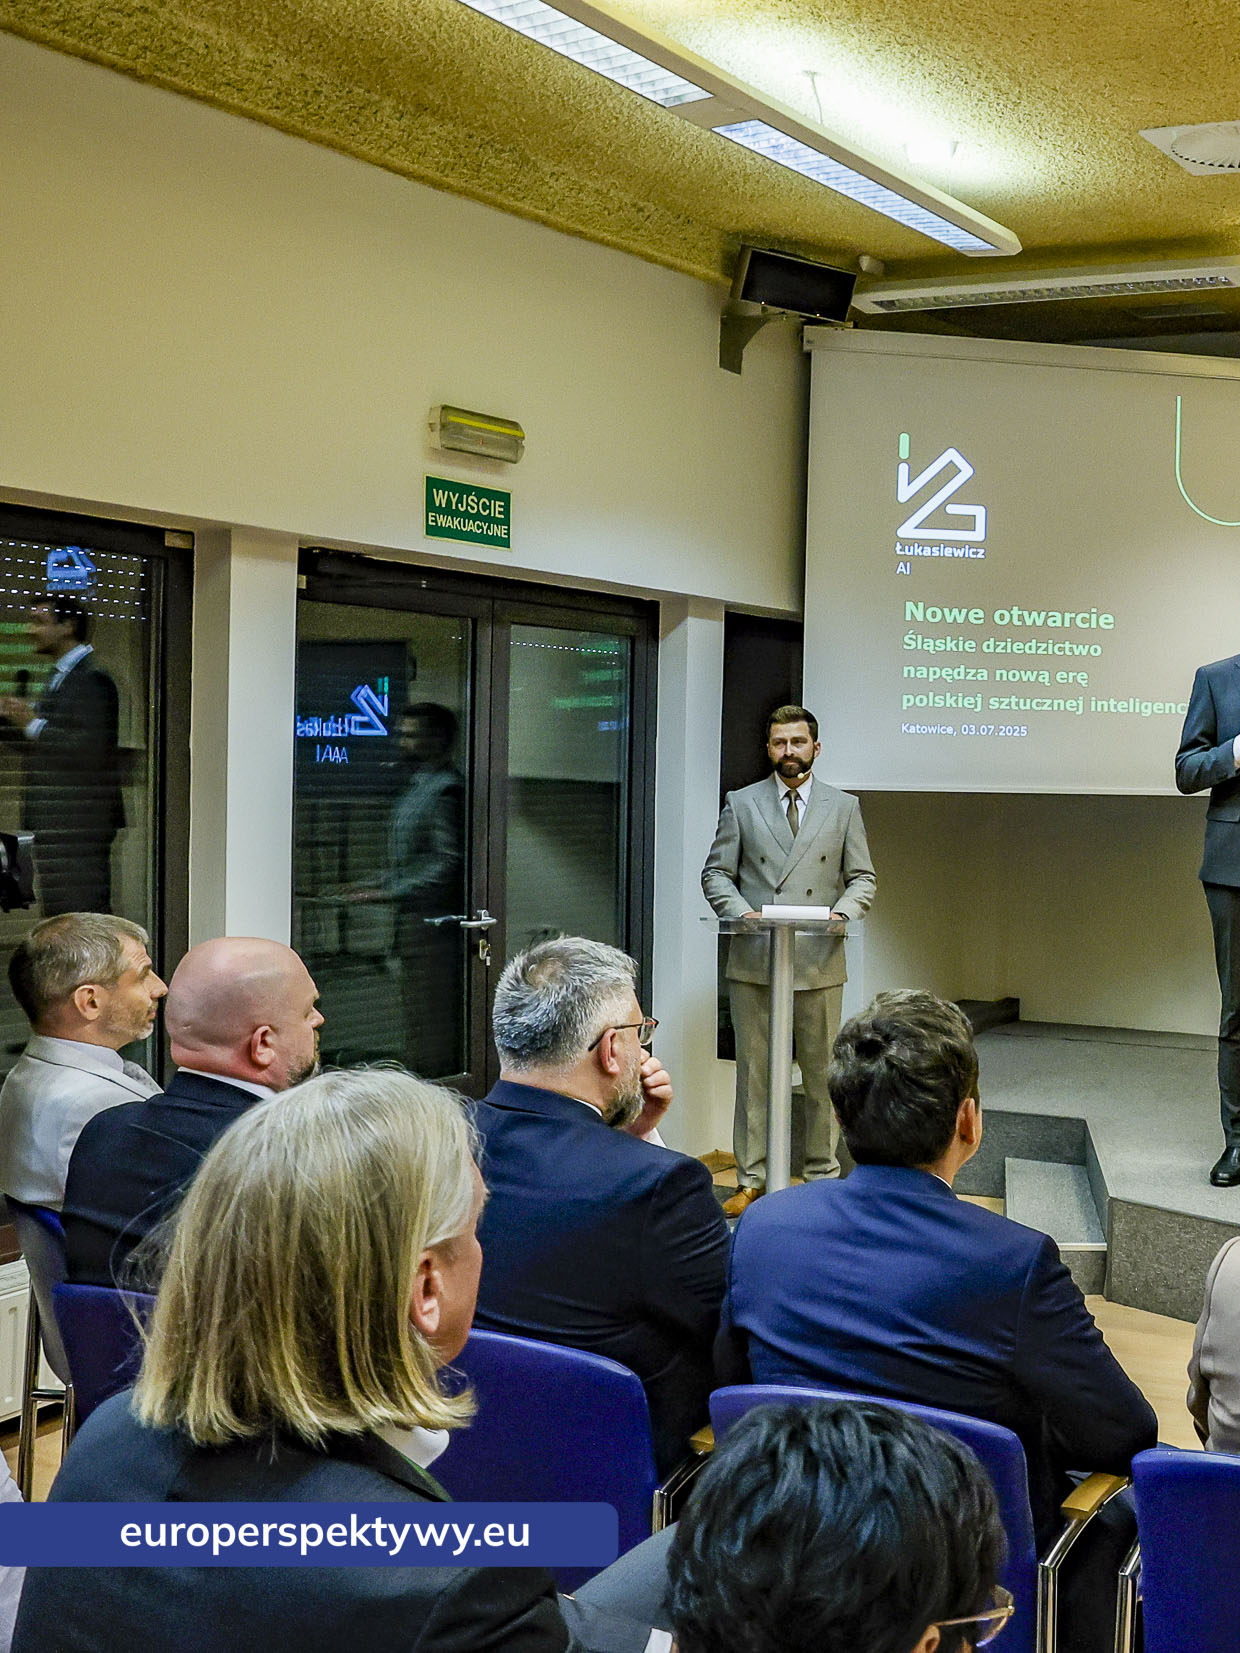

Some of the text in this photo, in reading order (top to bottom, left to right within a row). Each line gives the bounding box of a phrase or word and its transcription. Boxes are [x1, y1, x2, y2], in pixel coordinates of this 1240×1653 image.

[433, 488, 505, 519] WYJŚCIE
[428, 512, 508, 538] EWAKUACYJNE
[895, 541, 986, 559] Łukasiewicz
[896, 561, 911, 575] AI
[905, 601, 1115, 630] Nowe otwarcie
[903, 630, 1102, 656] Śląskie dziedzictwo
[903, 665, 1089, 687] napędza nową erę
[902, 692, 983, 712] polskiej
[988, 696, 1084, 715] sztucznej
[901, 723, 1028, 737] Katowice, 03.07.2025
